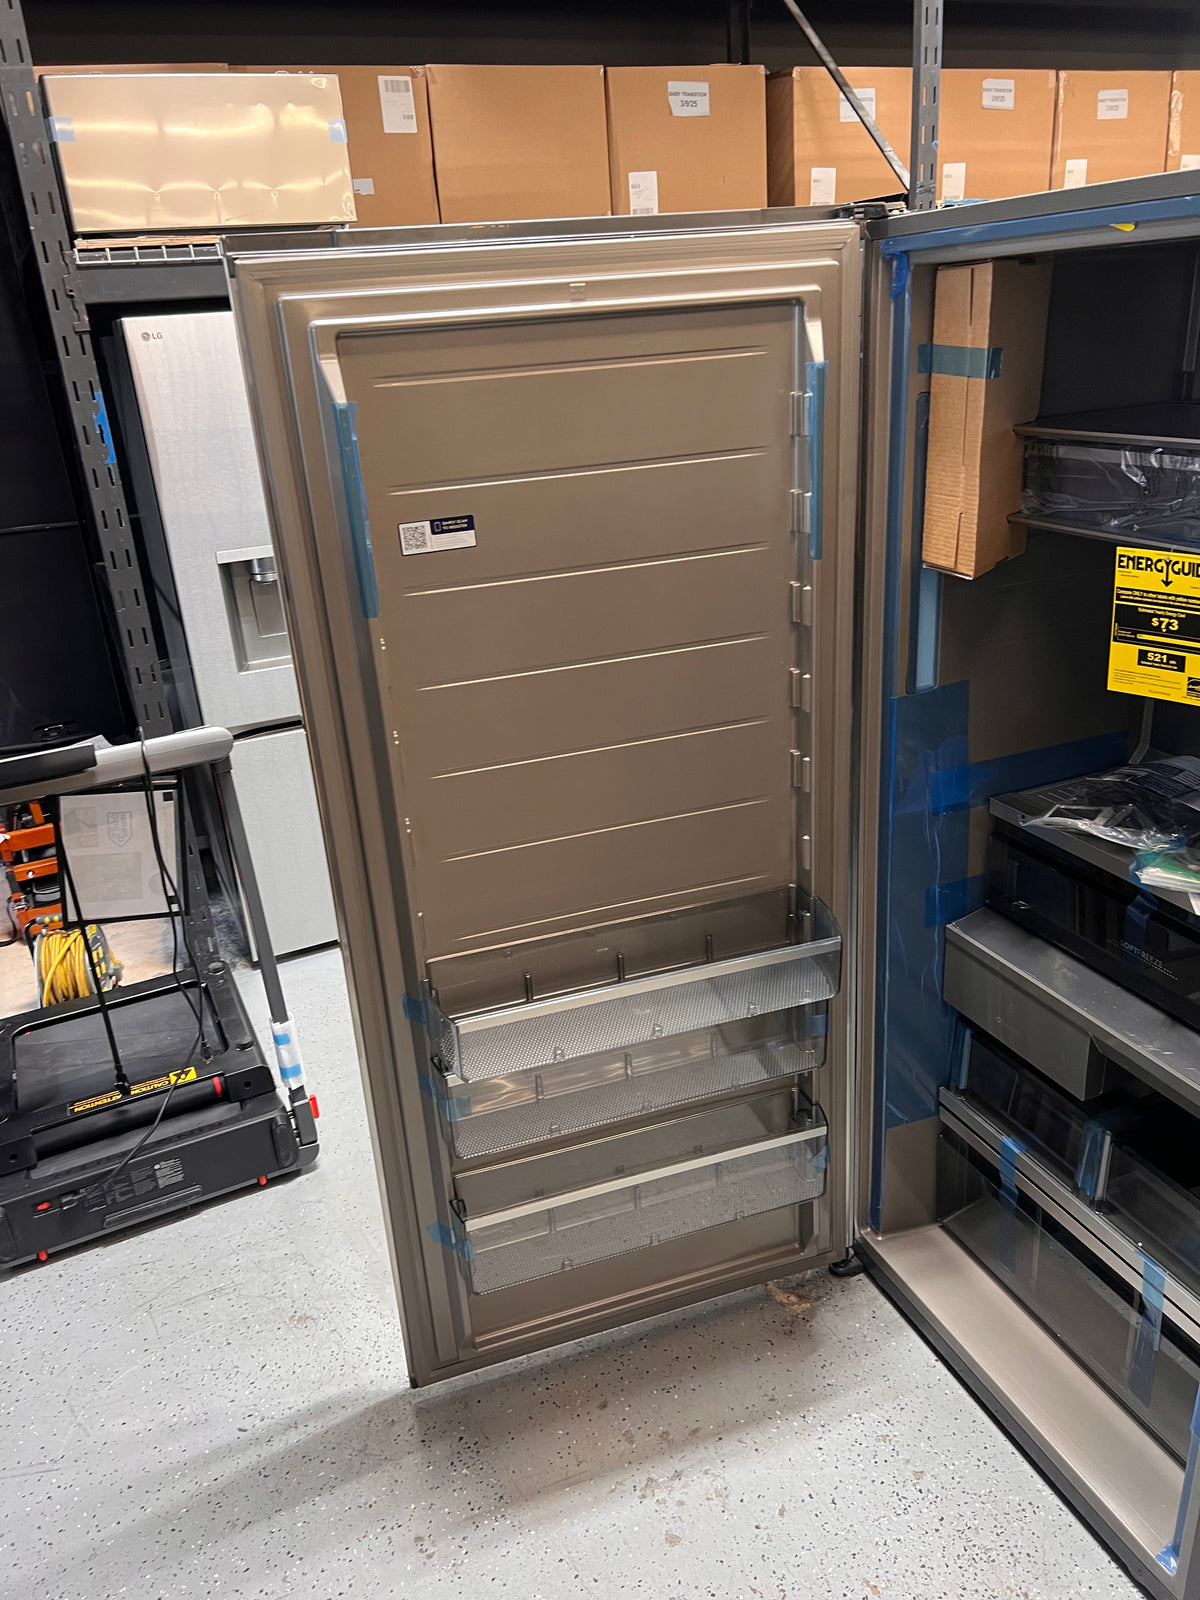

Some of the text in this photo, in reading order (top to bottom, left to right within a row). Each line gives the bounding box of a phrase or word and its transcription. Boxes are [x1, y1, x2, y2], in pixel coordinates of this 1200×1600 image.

[151, 332, 163, 340] LG
[1151, 617, 1179, 631] $73
[1147, 652, 1167, 663] 521
[130, 1080, 169, 1095] CAUTION
[74, 1093, 122, 1113] ATTENTION
